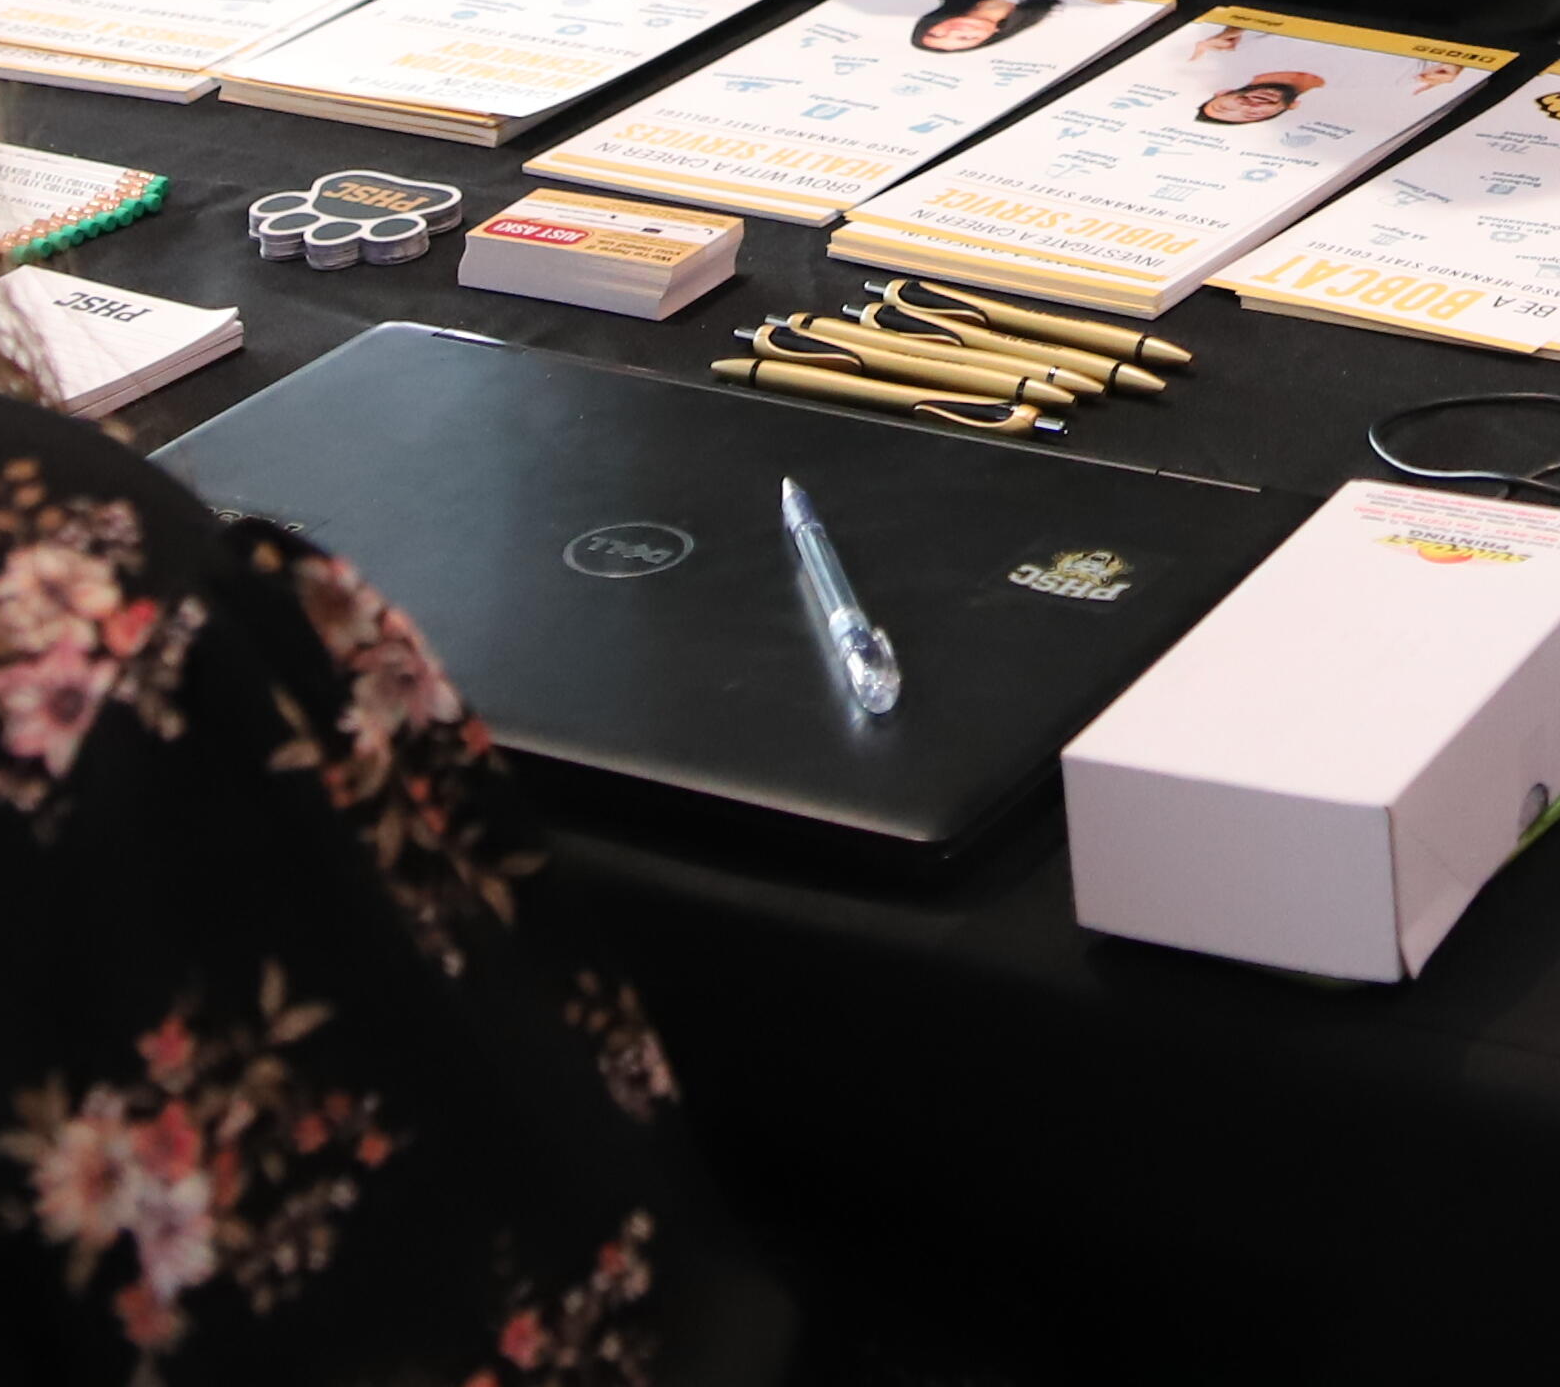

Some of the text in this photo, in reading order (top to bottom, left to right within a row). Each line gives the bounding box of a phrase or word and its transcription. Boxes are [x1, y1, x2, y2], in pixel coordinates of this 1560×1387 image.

[654, 108, 920, 157] PASCO-HERNANDO STATE COLLEGE
[1486, 141, 1530, 154] 70+
[613, 123, 894, 181] HEALTH SERVICES
[594, 142, 861, 195] GROW WITH A CAREER IN
[321, 181, 430, 214] PHSC
[923, 188, 1073, 230] SERVICE
[954, 169, 1231, 230] PASCO-HERNANDO STATE COLLEGE
[490, 221, 539, 238] ASK!
[910, 209, 937, 220] IN
[935, 214, 1017, 238] CAREER
[540, 225, 586, 243] JUST
[1018, 231, 1039, 241] A
[1063, 218, 1200, 256] PUBLIC
[1032, 236, 1166, 268] INVESTIGATE
[1306, 241, 1373, 260] COLLEGE
[1377, 255, 1425, 270] STATE
[1248, 254, 1559, 321] BE A BOBCAT
[52, 291, 153, 323] PHSC
[586, 537, 674, 565] DELL
[1407, 528, 1511, 551] PRINTING
[1007, 564, 1133, 602] PHSC
